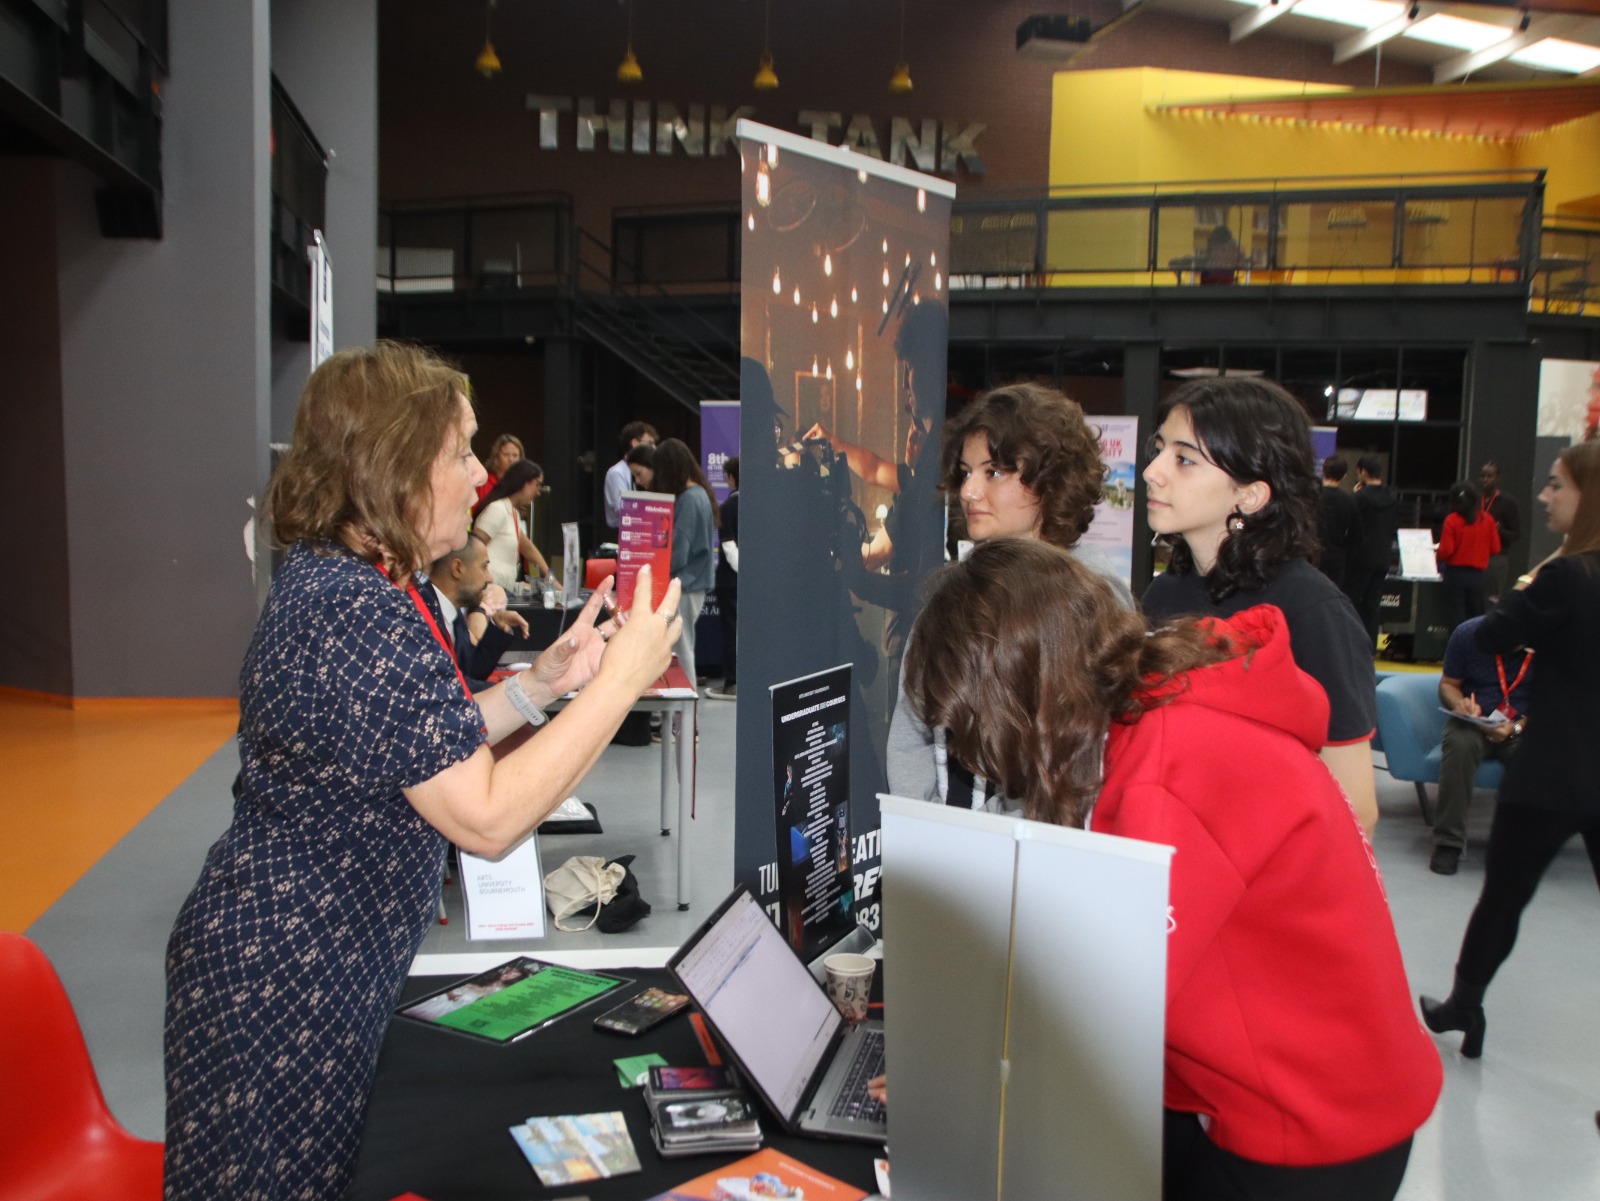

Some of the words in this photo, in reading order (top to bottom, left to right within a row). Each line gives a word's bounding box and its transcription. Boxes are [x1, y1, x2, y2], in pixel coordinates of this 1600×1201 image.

[525, 93, 757, 157] THINK
[798, 109, 987, 174] TANK
[708, 452, 729, 465] 8th
[781, 703, 820, 723] UNDERGRADUATE
[826, 695, 846, 708] COURSES
[478, 880, 512, 888] UNIVERSITY
[479, 886, 526, 895] BOURNEMOUTH
